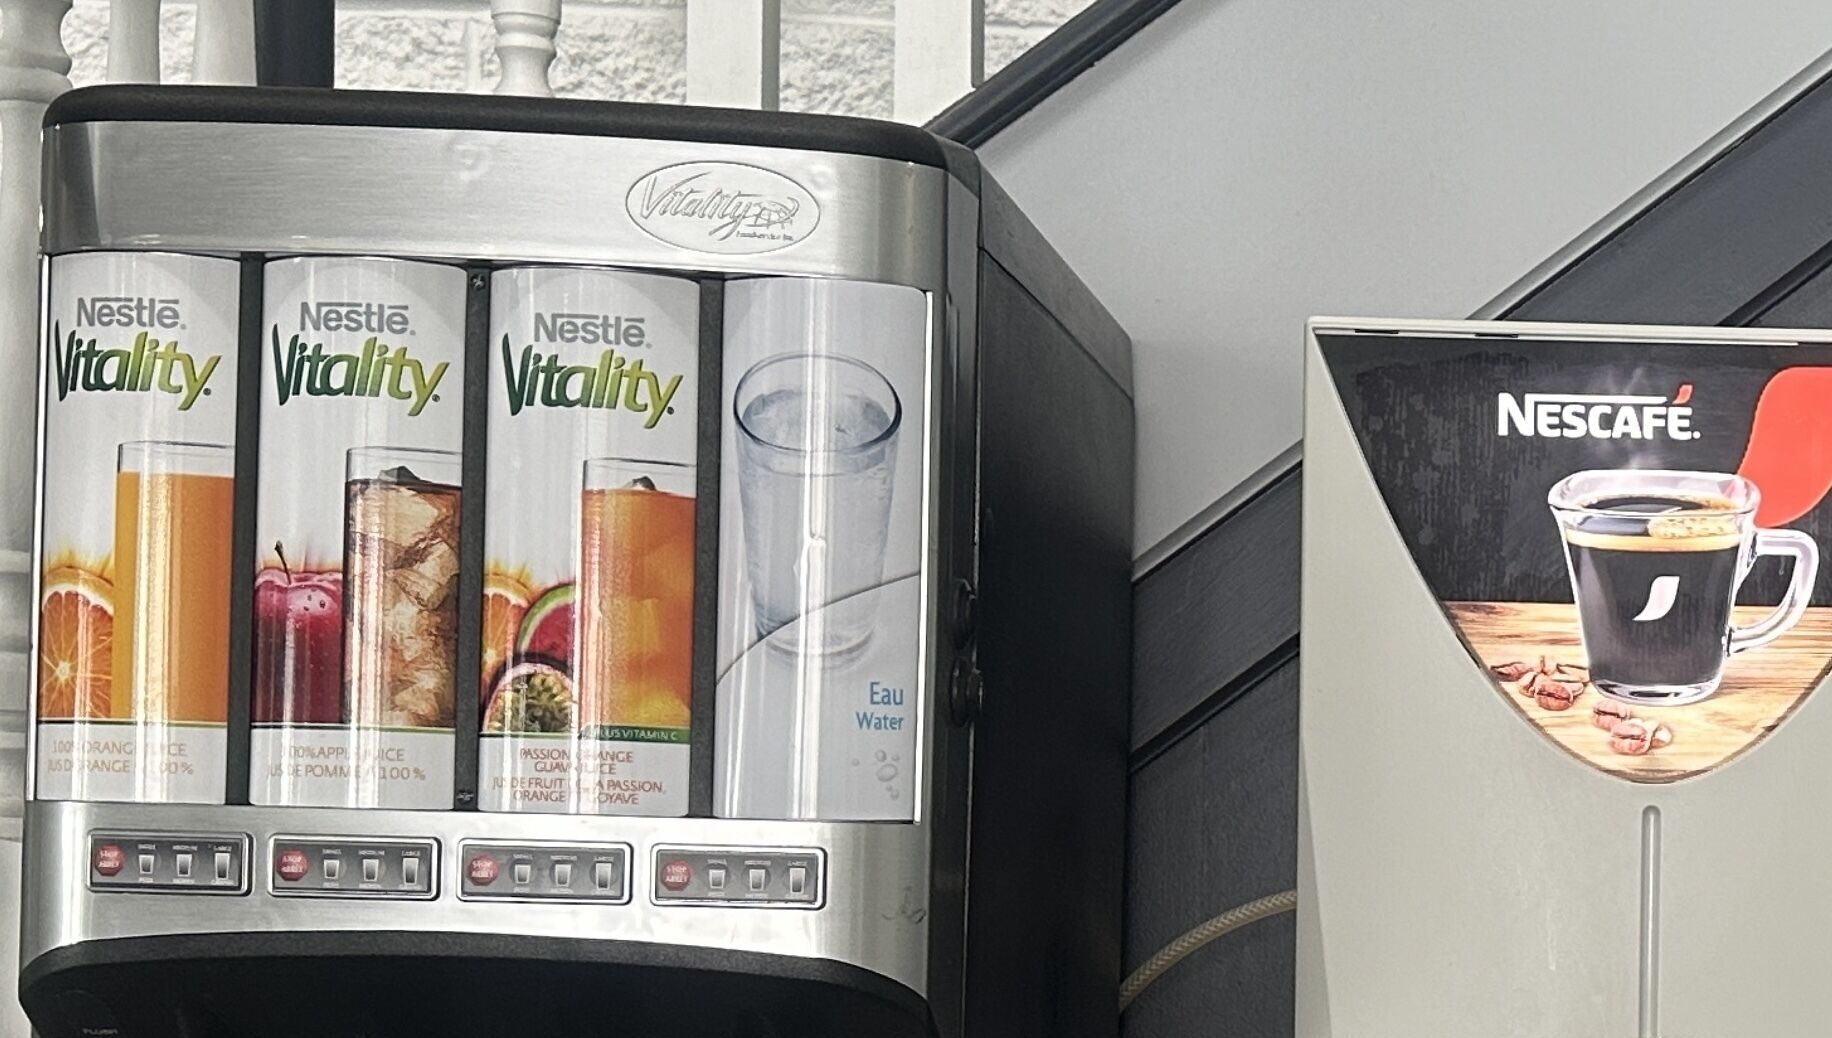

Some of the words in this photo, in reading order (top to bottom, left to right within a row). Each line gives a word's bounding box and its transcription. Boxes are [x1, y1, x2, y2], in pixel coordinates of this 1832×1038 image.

[870, 681, 904, 706] Eau
[856, 711, 904, 730] Water
[82, 740, 134, 755] ORANG
